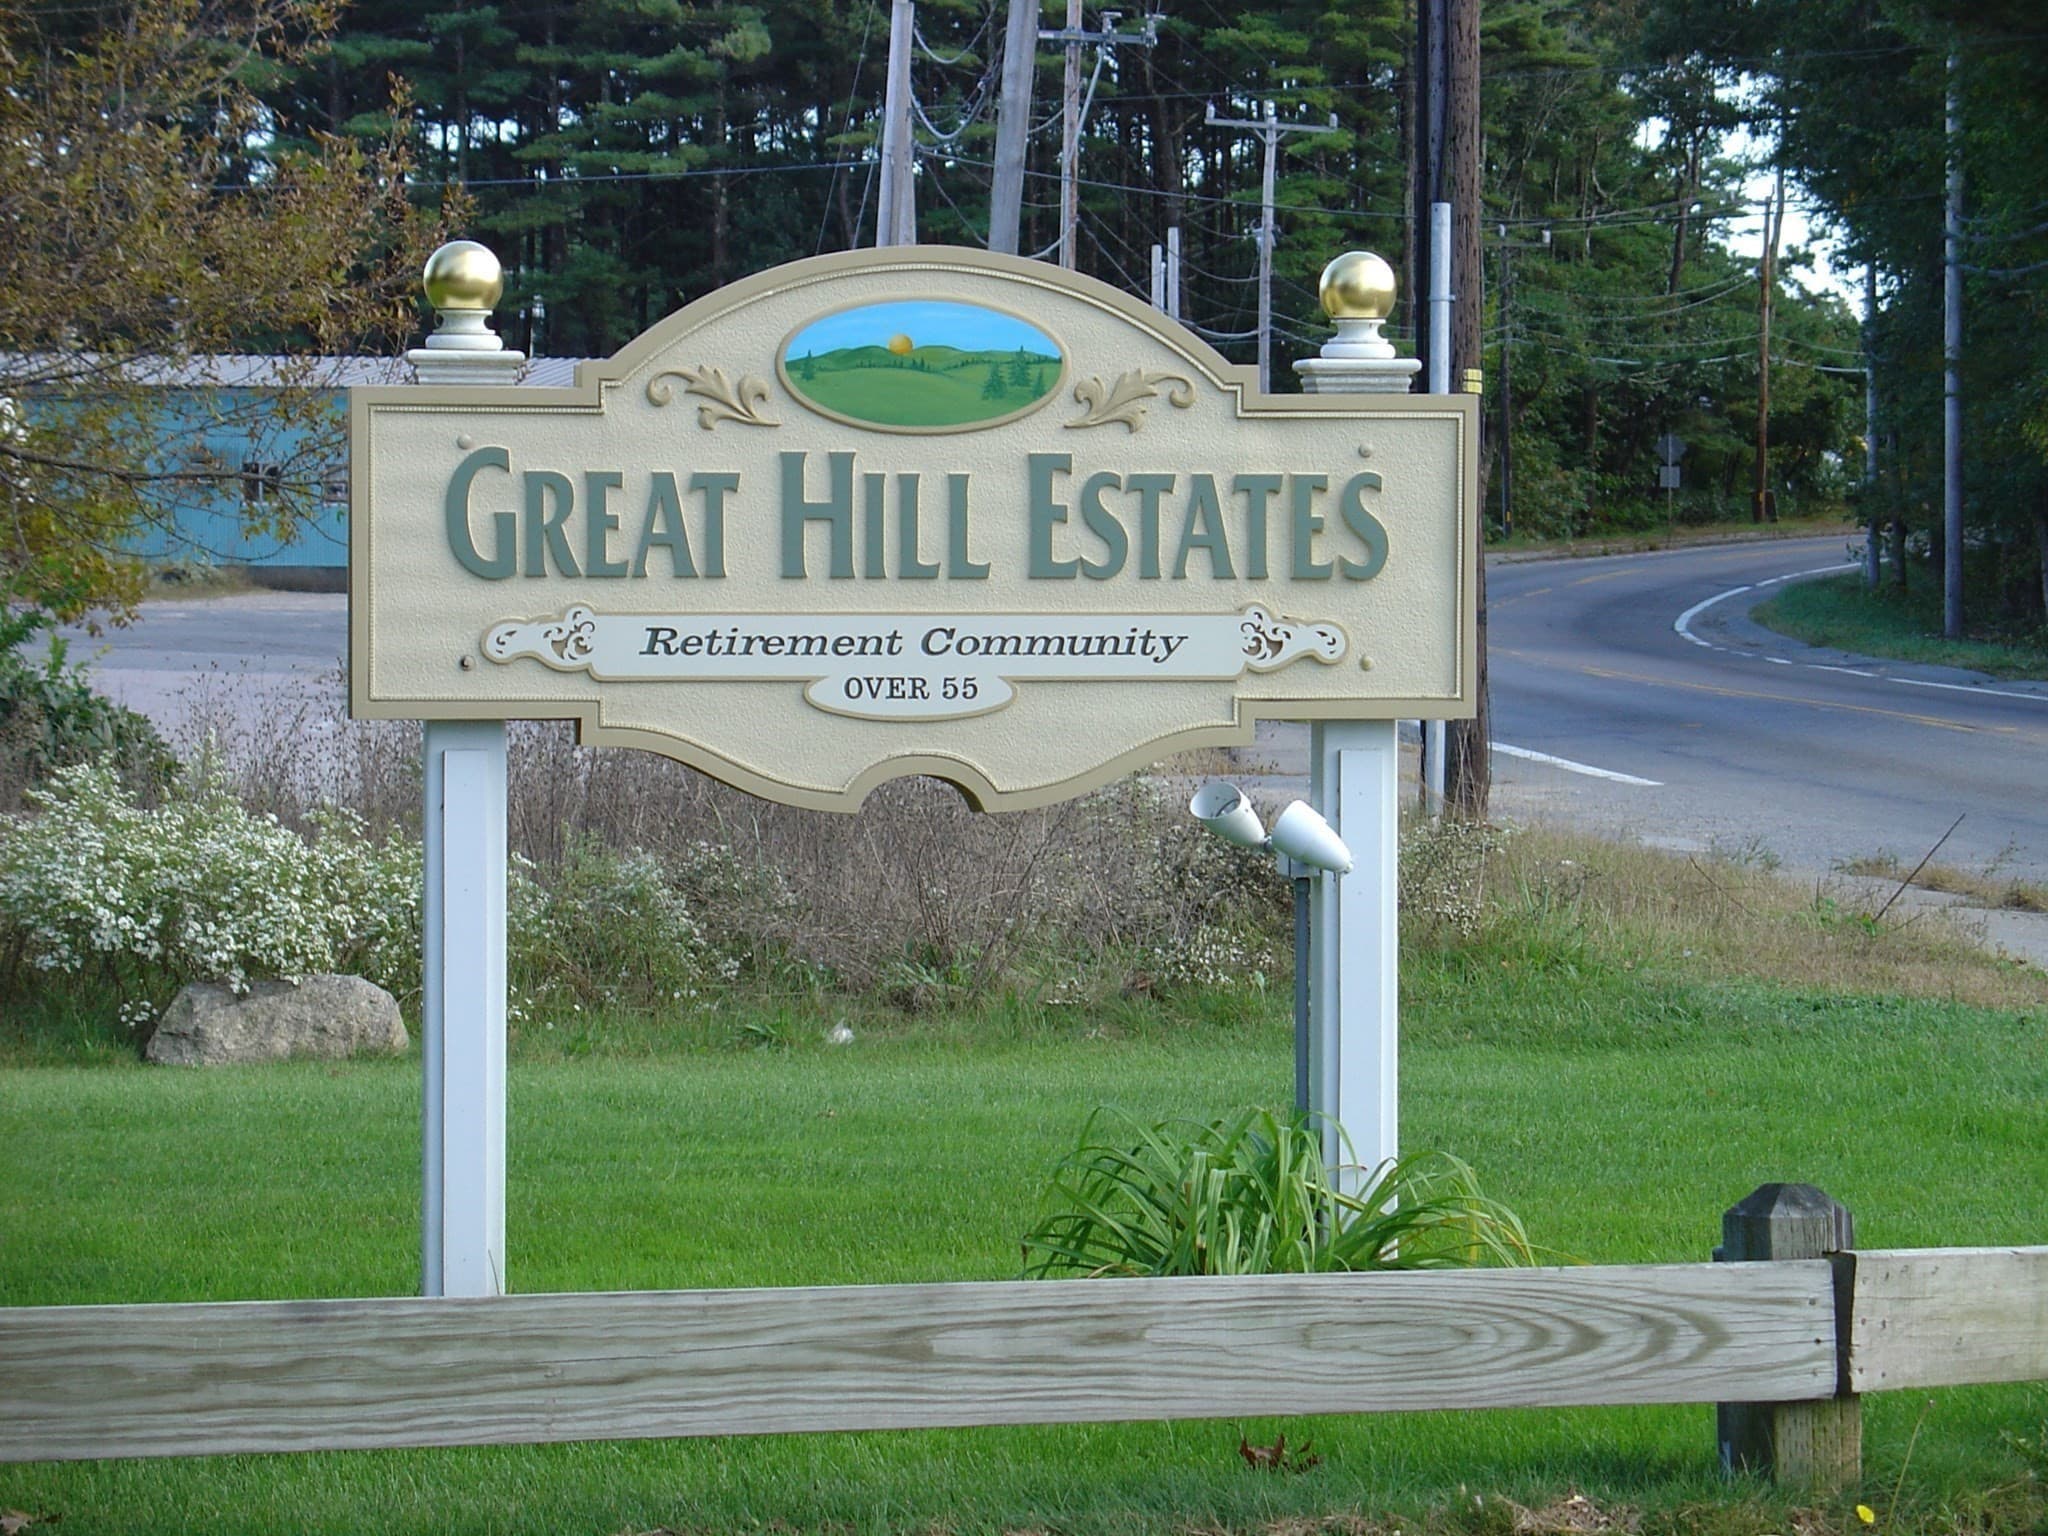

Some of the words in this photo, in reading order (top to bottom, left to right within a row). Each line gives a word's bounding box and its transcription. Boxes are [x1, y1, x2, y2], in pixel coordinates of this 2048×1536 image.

[446, 446, 741, 580] GREAT
[780, 450, 991, 579] HILL
[1028, 453, 1390, 580] ESTATES
[639, 626, 903, 657] Retirement
[921, 626, 1188, 663] Community
[843, 676, 931, 700] OVER
[941, 676, 978, 700] 55
